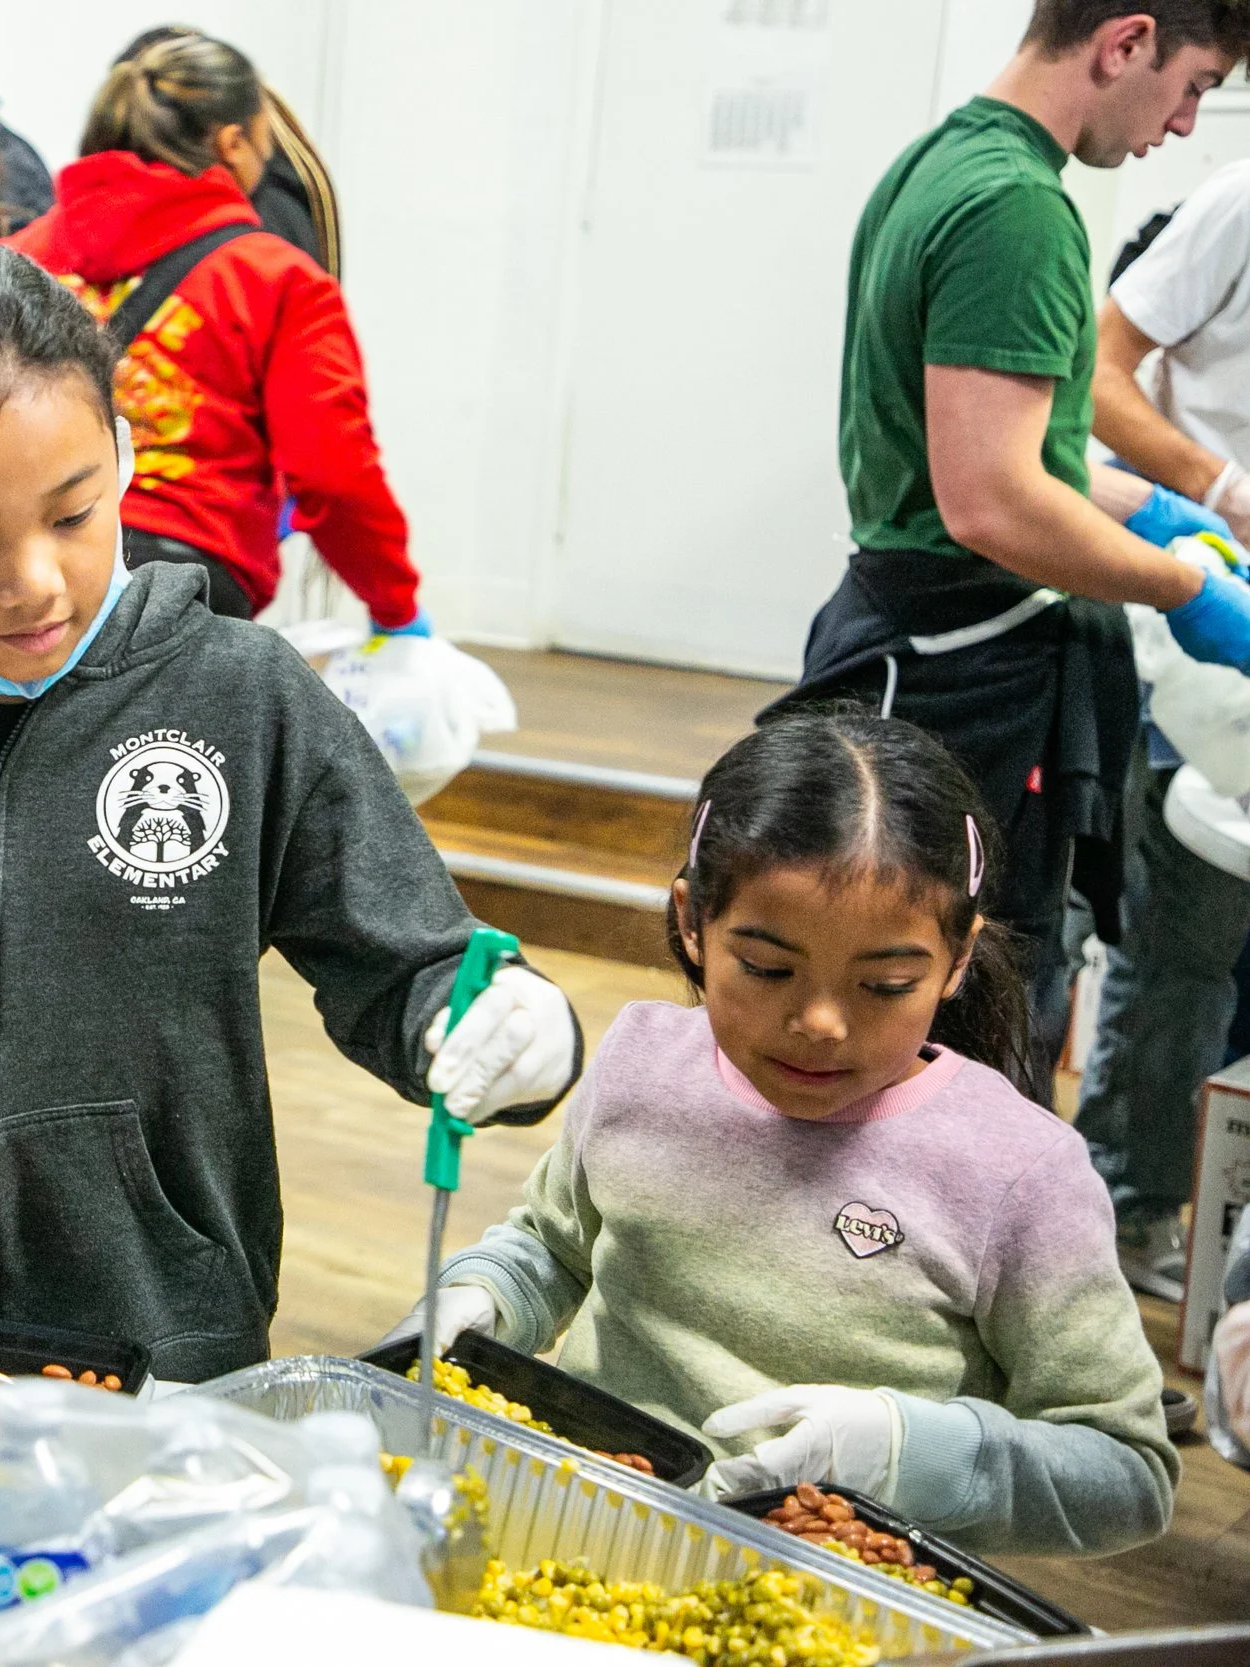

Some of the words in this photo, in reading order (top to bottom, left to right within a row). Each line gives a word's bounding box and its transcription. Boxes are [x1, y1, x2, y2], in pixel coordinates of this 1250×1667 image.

[109, 729, 226, 767] MONTCLAIR
[86, 834, 230, 888] ELEMENTARY
[172, 896, 186, 904] CA
[834, 1214, 897, 1245] Levi's
